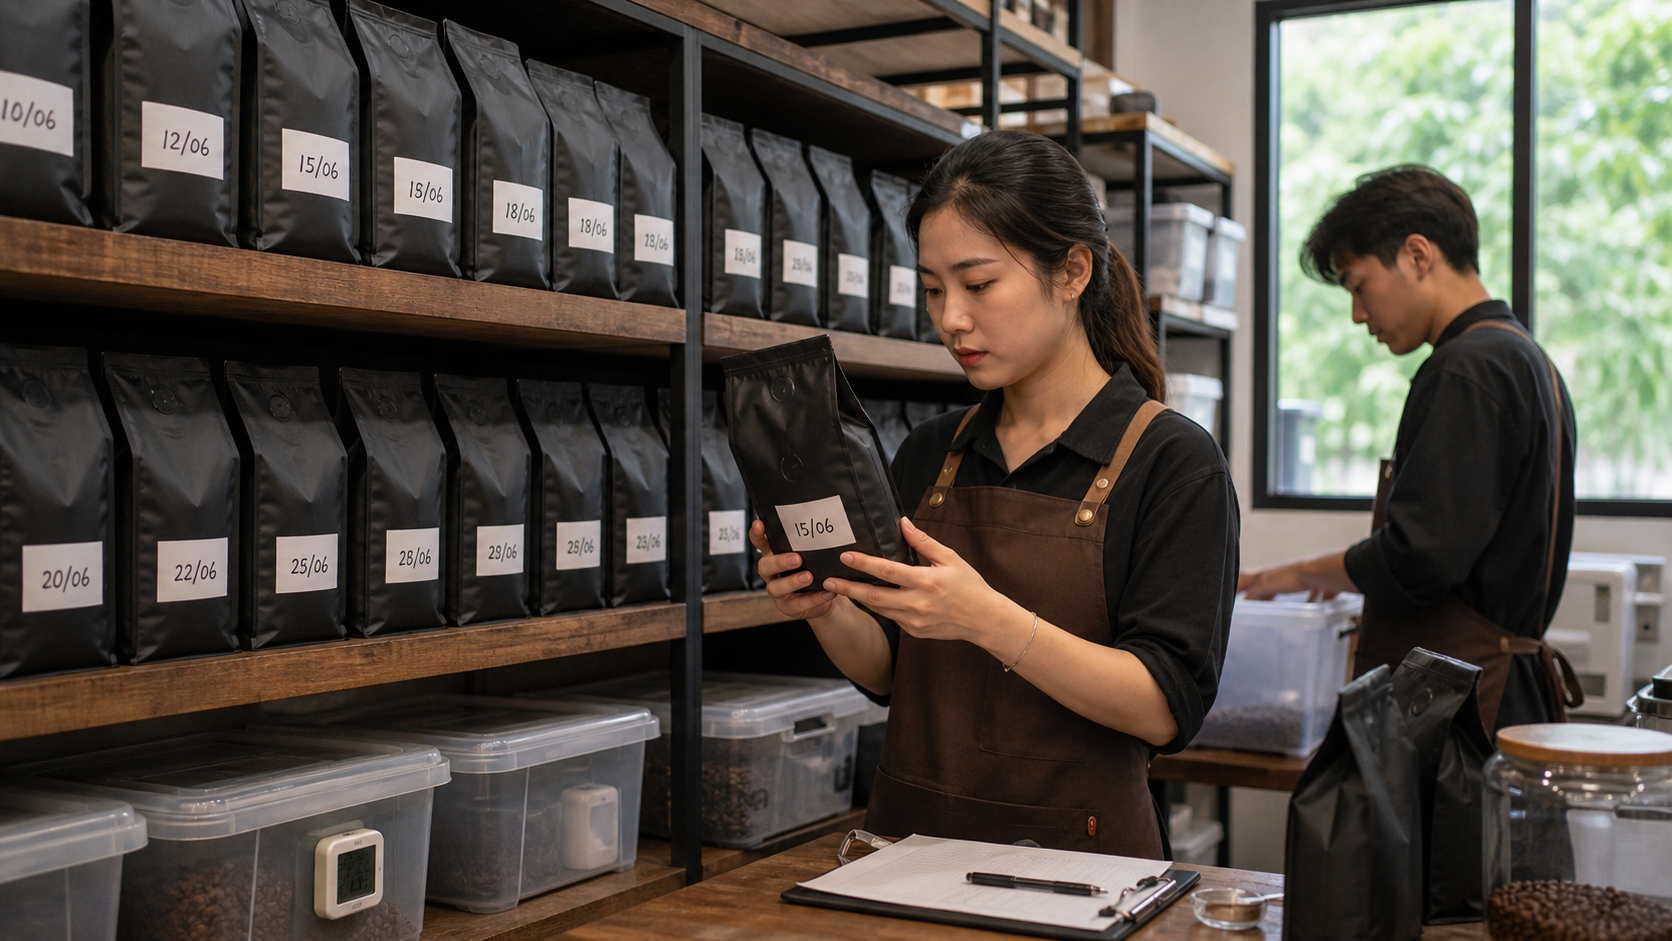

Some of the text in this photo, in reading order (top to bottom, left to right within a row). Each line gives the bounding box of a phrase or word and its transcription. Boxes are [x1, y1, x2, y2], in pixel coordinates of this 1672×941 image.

[1, 99, 56, 130] 10/06
[163, 130, 210, 156] 12/06
[300, 155, 338, 179] 15/06
[506, 203, 535, 223] 18/06
[581, 218, 607, 237] 18/06
[795, 518, 834, 538] 15/06
[291, 554, 328, 578] 25/06
[399, 548, 431, 569] 28/06
[42, 565, 90, 592] 20/06
[174, 560, 216, 584] 22/06
